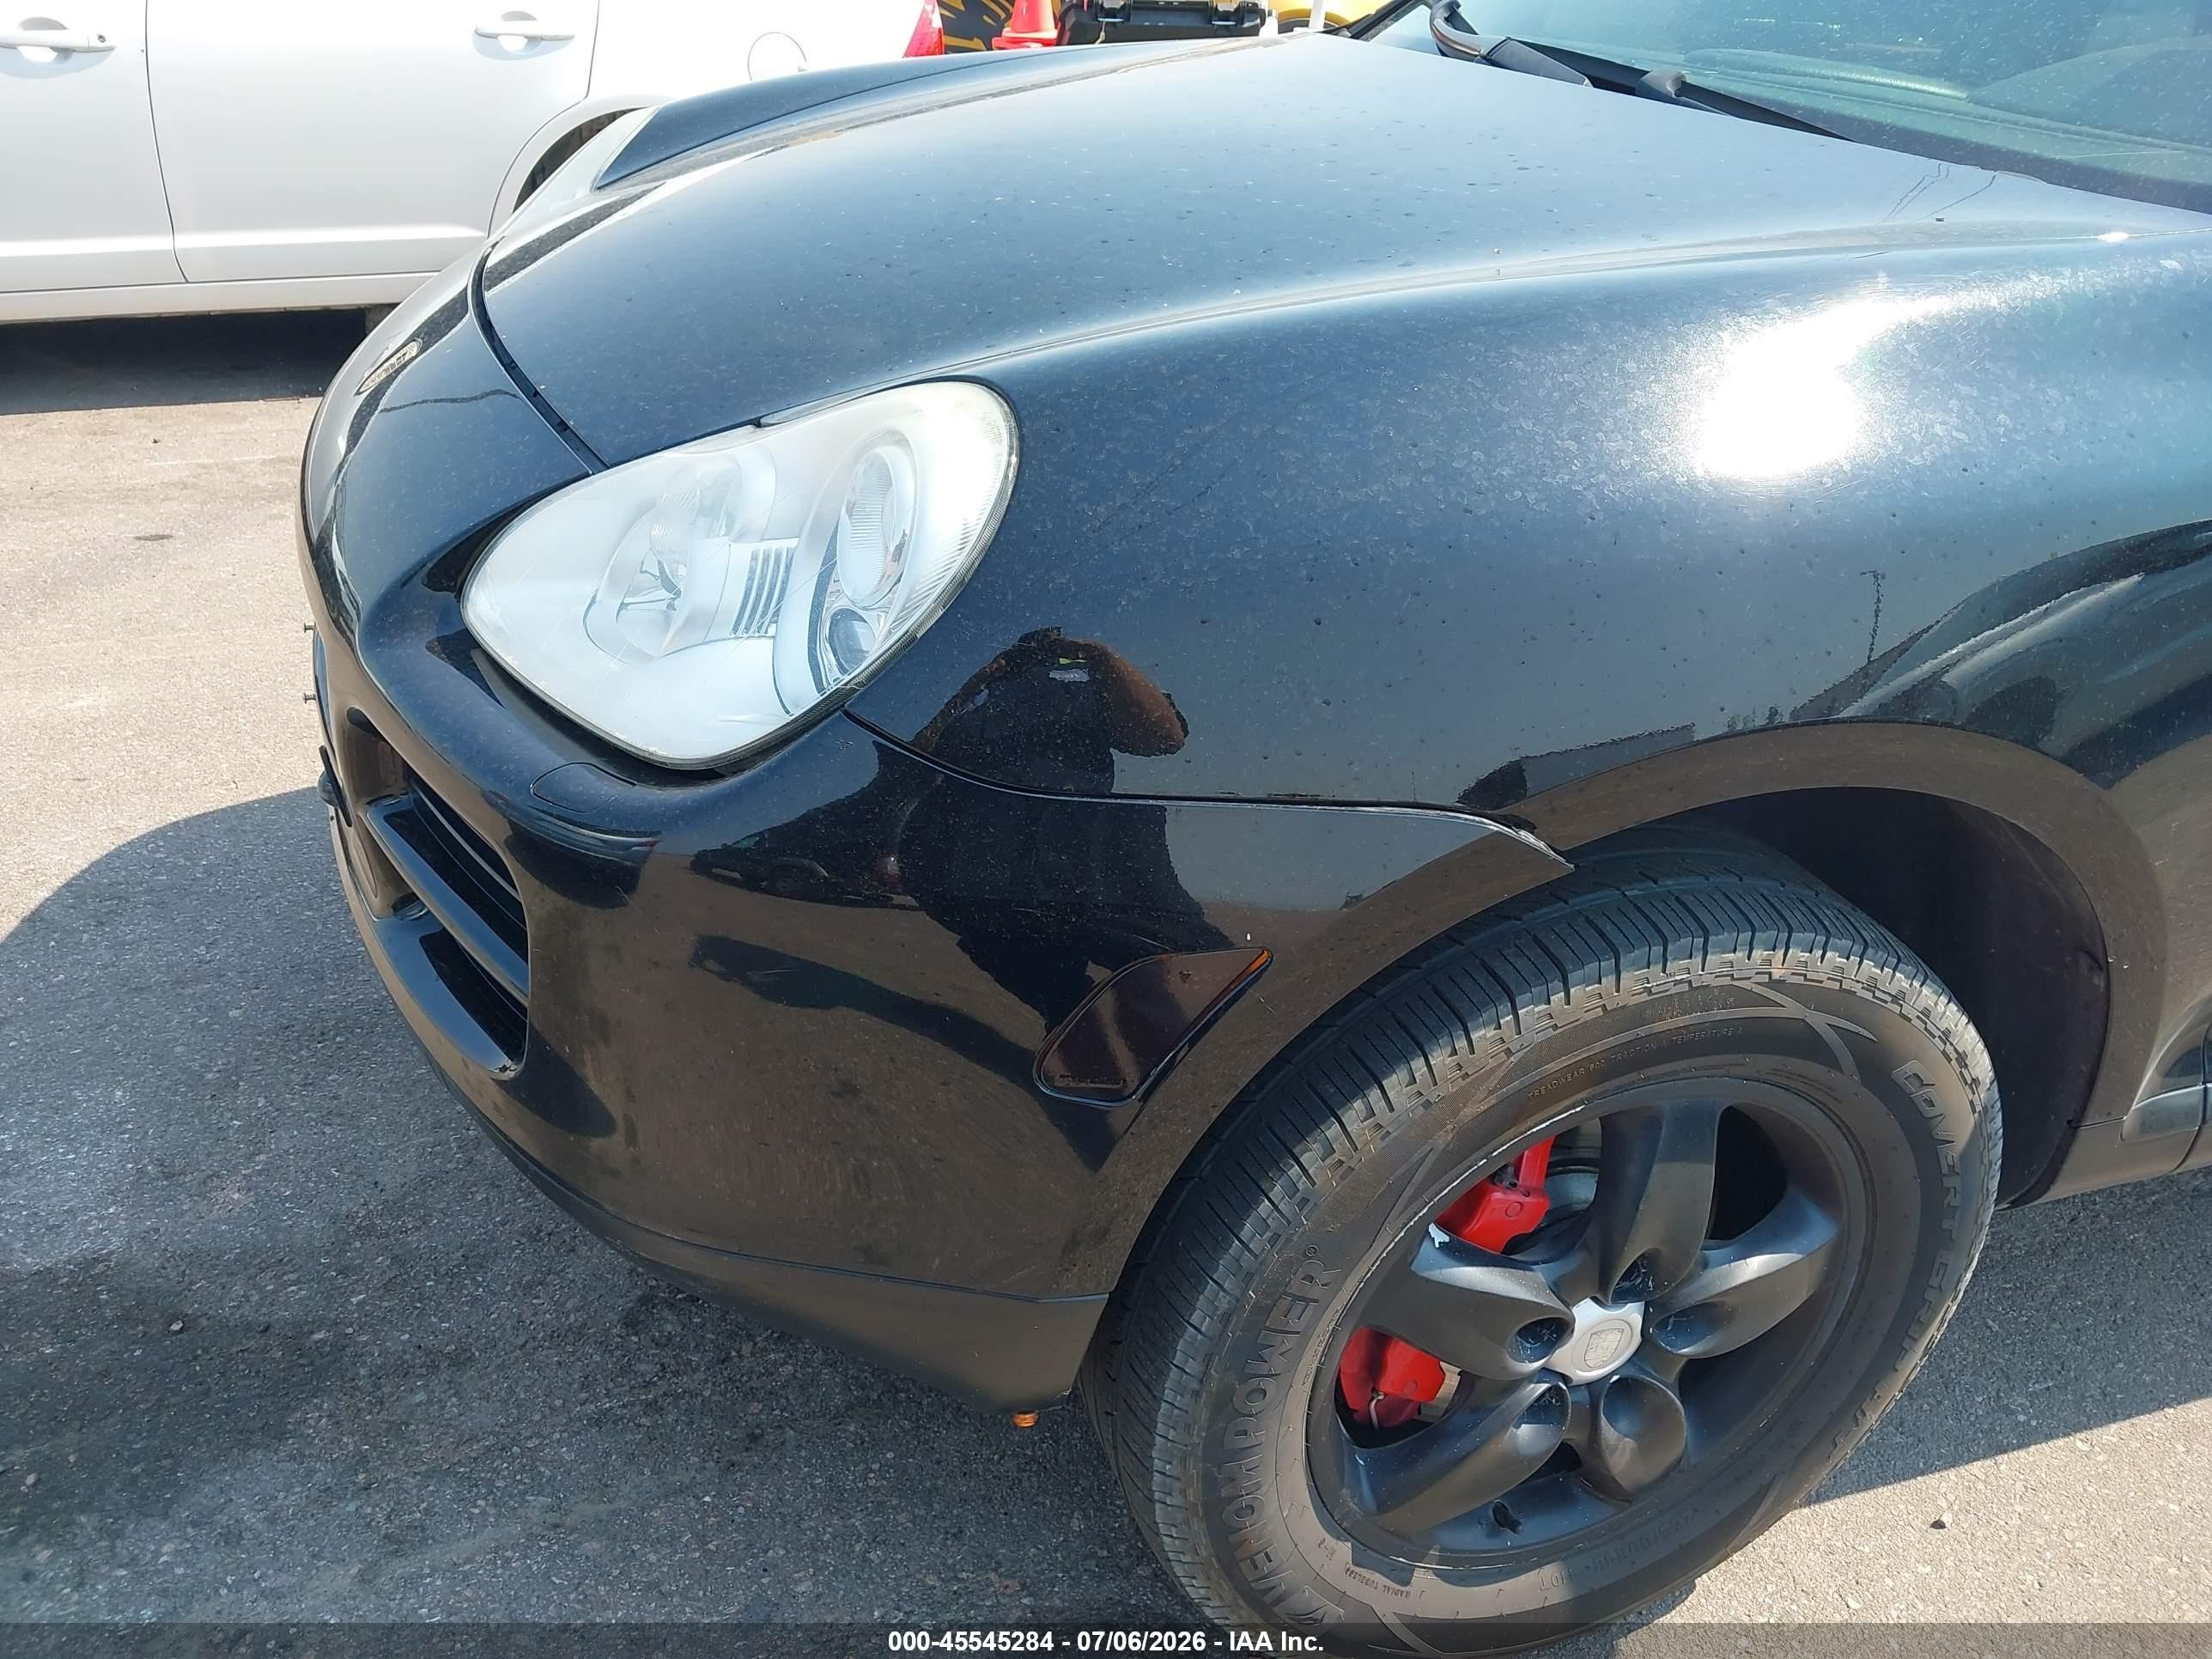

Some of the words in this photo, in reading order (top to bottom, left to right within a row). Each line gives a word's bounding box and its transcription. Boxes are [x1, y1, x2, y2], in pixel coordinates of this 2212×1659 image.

[1528, 1067, 1586, 1100] TREADWEAR
[1609, 1042, 1657, 1062] TRACTION
[1671, 1027, 1734, 1045] TEMPERATURE
[1890, 1060, 1962, 1242] COVERT
